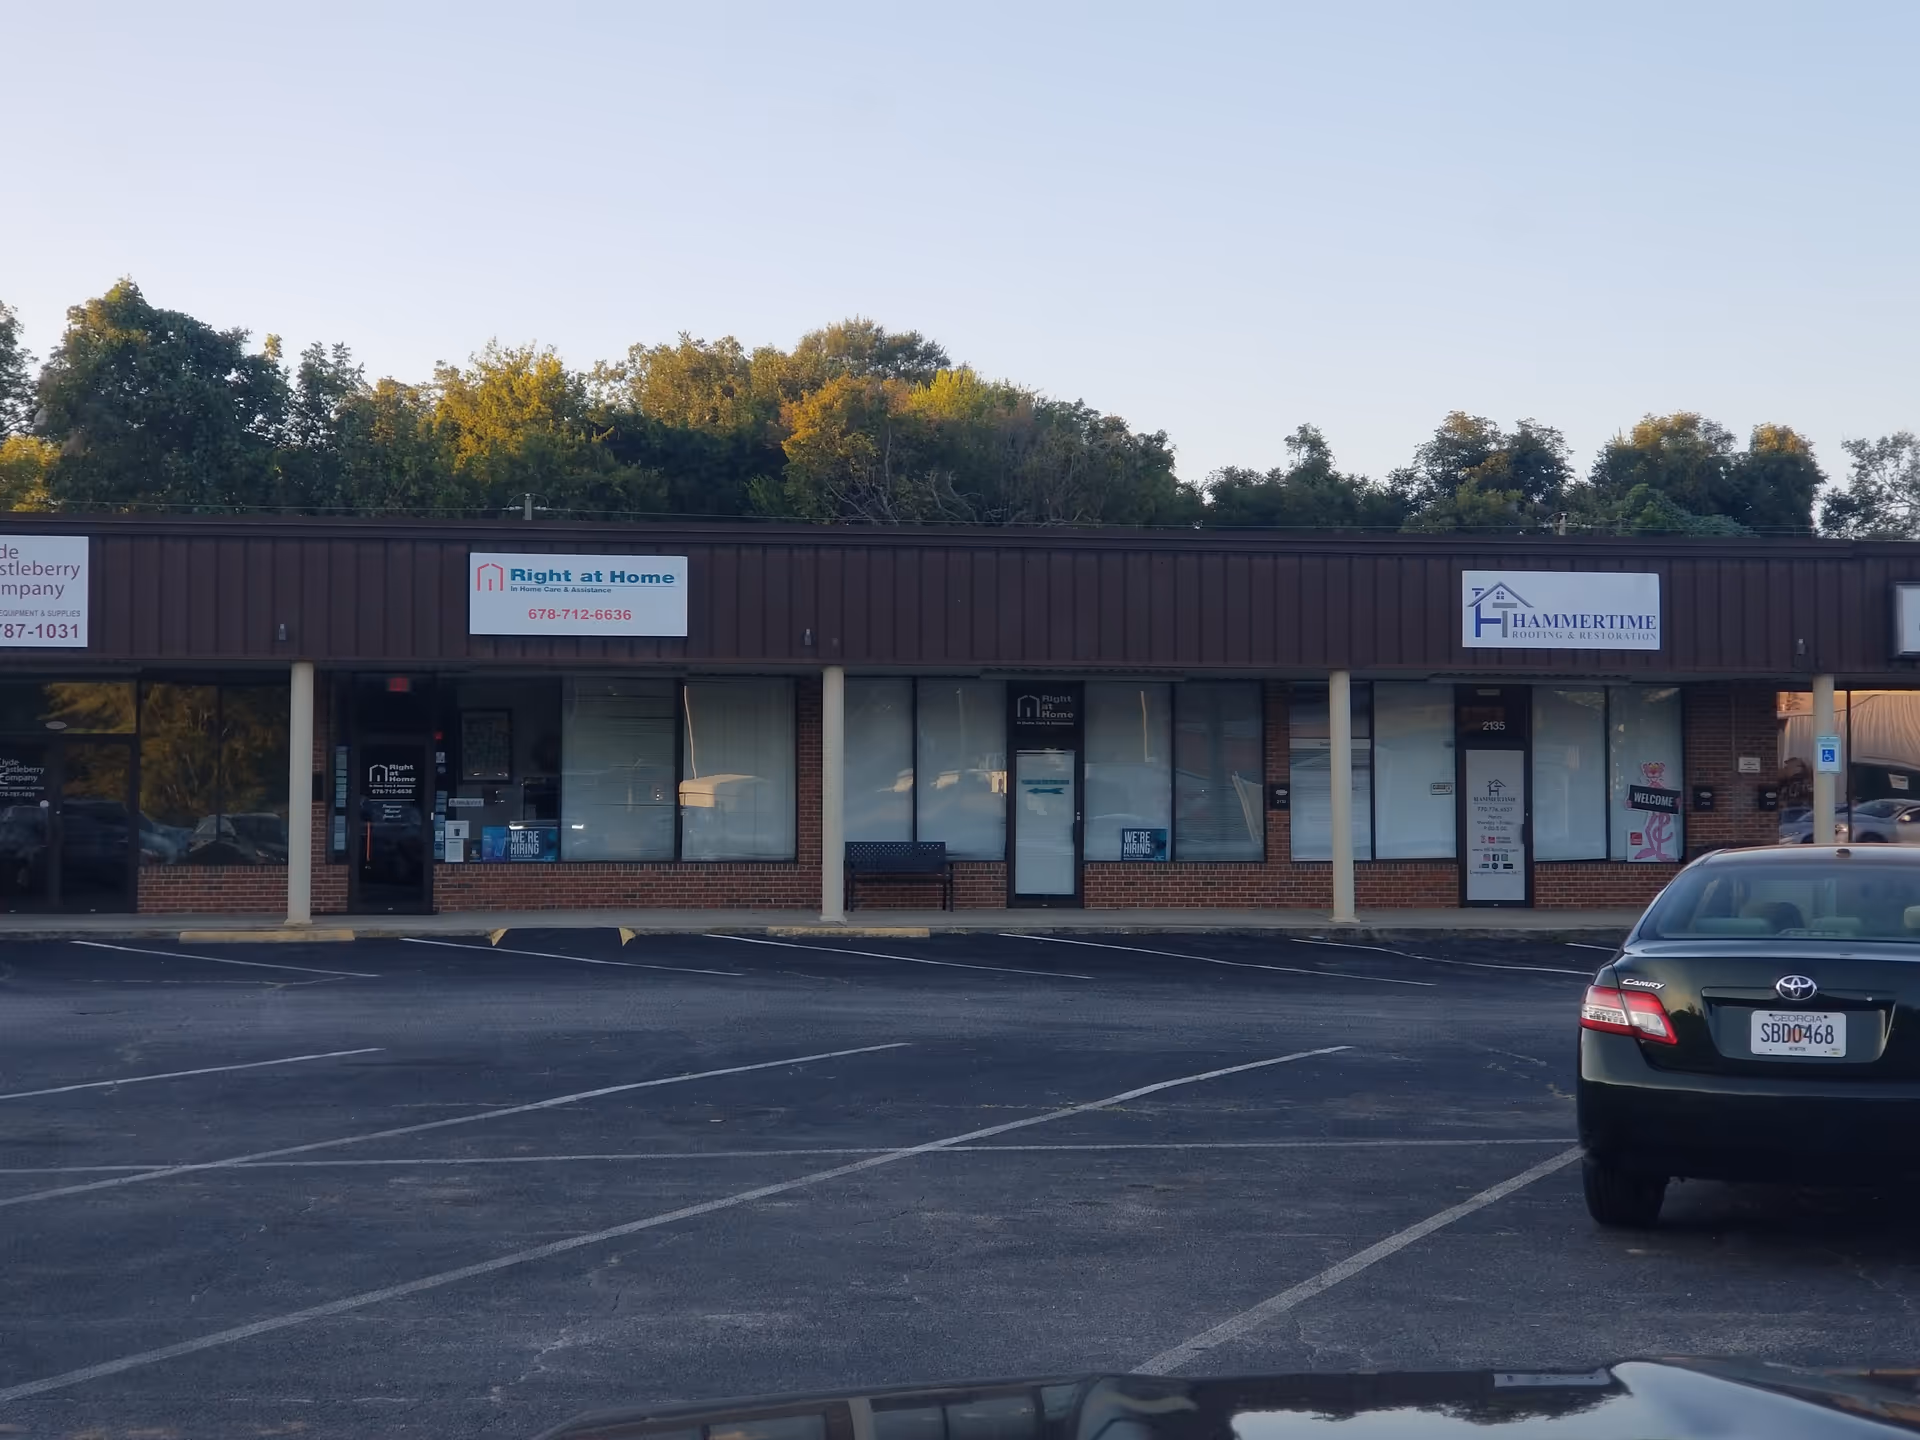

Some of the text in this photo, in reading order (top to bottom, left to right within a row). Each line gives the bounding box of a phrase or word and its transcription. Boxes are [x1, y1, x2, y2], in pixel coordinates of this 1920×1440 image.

[510, 568, 675, 585] Right at Home
[528, 608, 632, 620] 678-712-6636
[1512, 613, 1657, 630] HAMMERTIME
[0, 623, 79, 639] 87-1031
[1512, 631, 1657, 641] ROOFING & RESTORATION
[1041, 694, 1072, 703] Right
[1041, 710, 1074, 718] Home
[1482, 720, 1506, 731] 2135
[0, 758, 20, 767] lyde
[1633, 791, 1675, 807] WELCOME
[510, 831, 540, 843] WE'RE
[1124, 831, 1151, 843] WE'RE
[510, 843, 540, 855] HIRING
[1123, 842, 1151, 854] HIRING
[1622, 978, 1666, 990] CAMRY
[1772, 1014, 1823, 1023] GEORGIA
[1760, 1022, 1835, 1045] SBD0468
